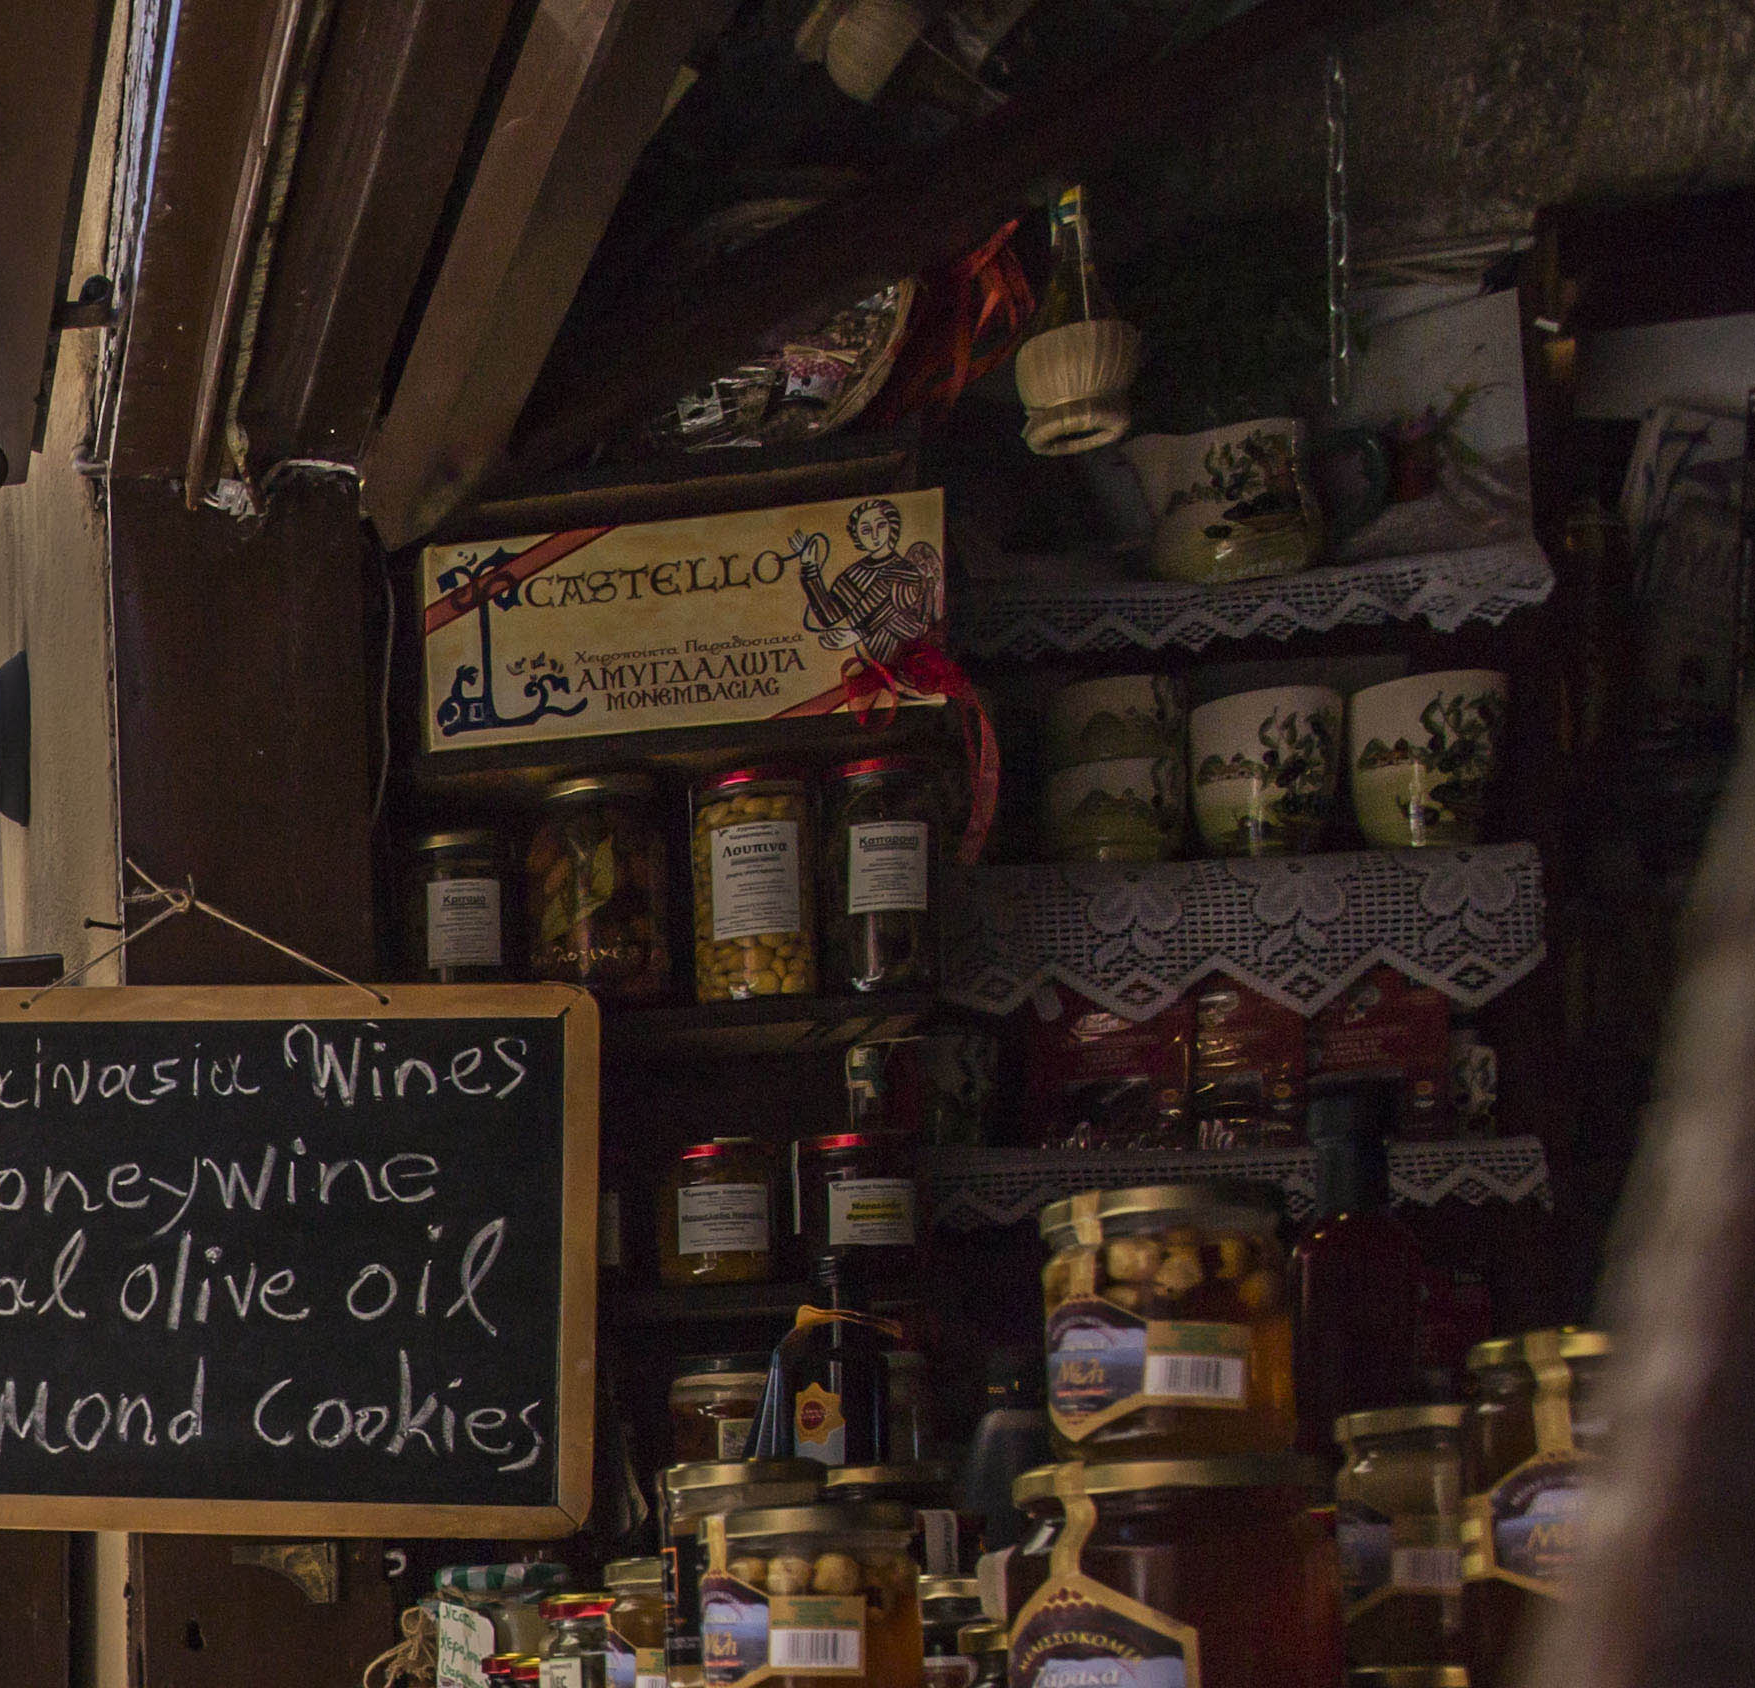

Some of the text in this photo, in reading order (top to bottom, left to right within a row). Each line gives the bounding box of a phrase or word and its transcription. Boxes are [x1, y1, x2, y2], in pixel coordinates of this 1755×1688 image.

[525, 551, 786, 607] CASTELLO
[284, 1021, 528, 1108] Wines
[120, 1229, 311, 1331] olive
[346, 1216, 506, 1338] oil
